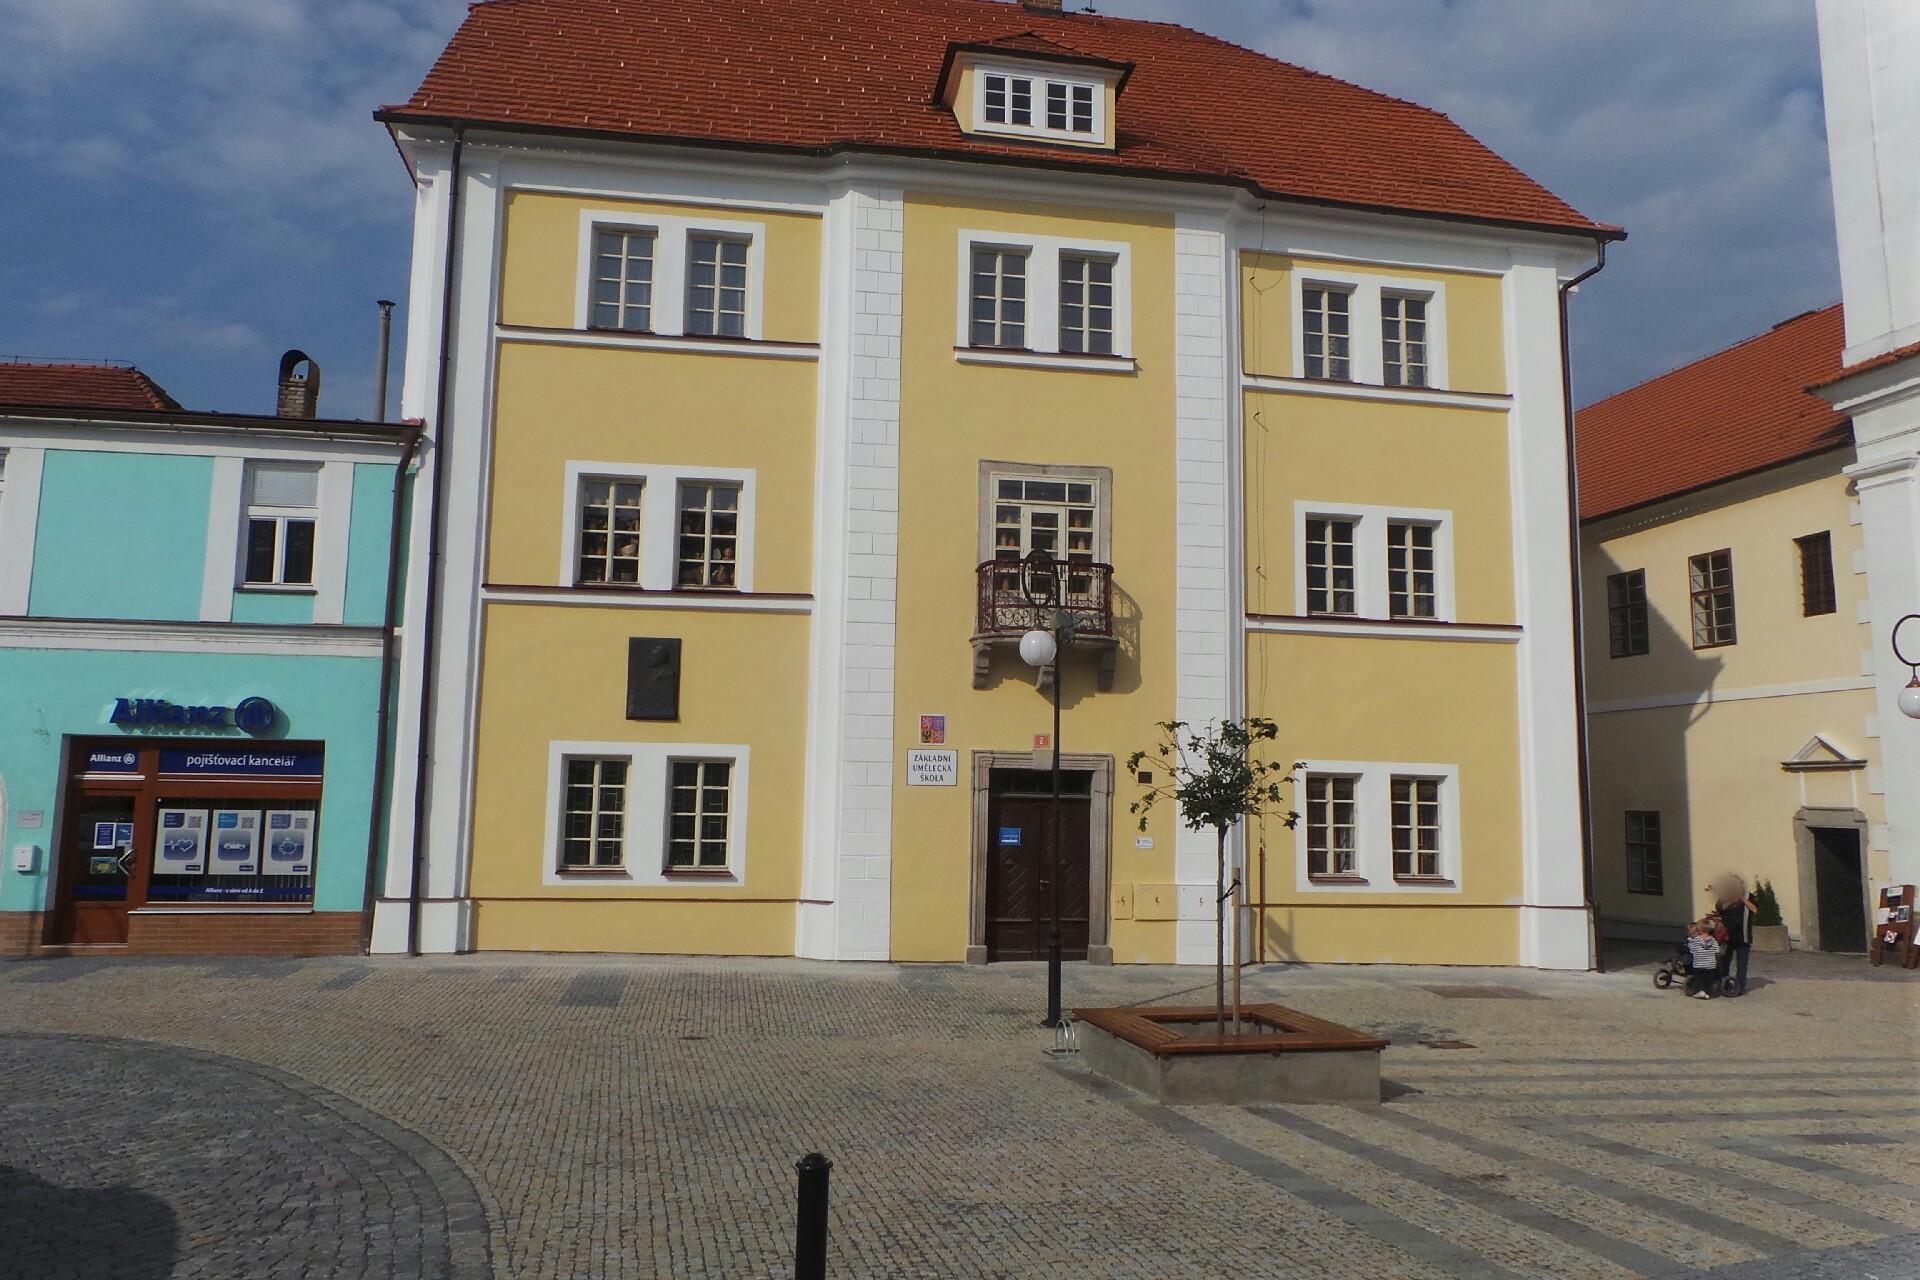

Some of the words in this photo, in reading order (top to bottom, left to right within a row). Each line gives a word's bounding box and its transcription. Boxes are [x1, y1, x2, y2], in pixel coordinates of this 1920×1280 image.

[109, 698, 228, 727] Allianz
[89, 753, 122, 763] Allianz
[186, 753, 246, 768] pojišťovací
[248, 754, 296, 768] kancelář
[920, 773, 944, 782] ŠKOLA
